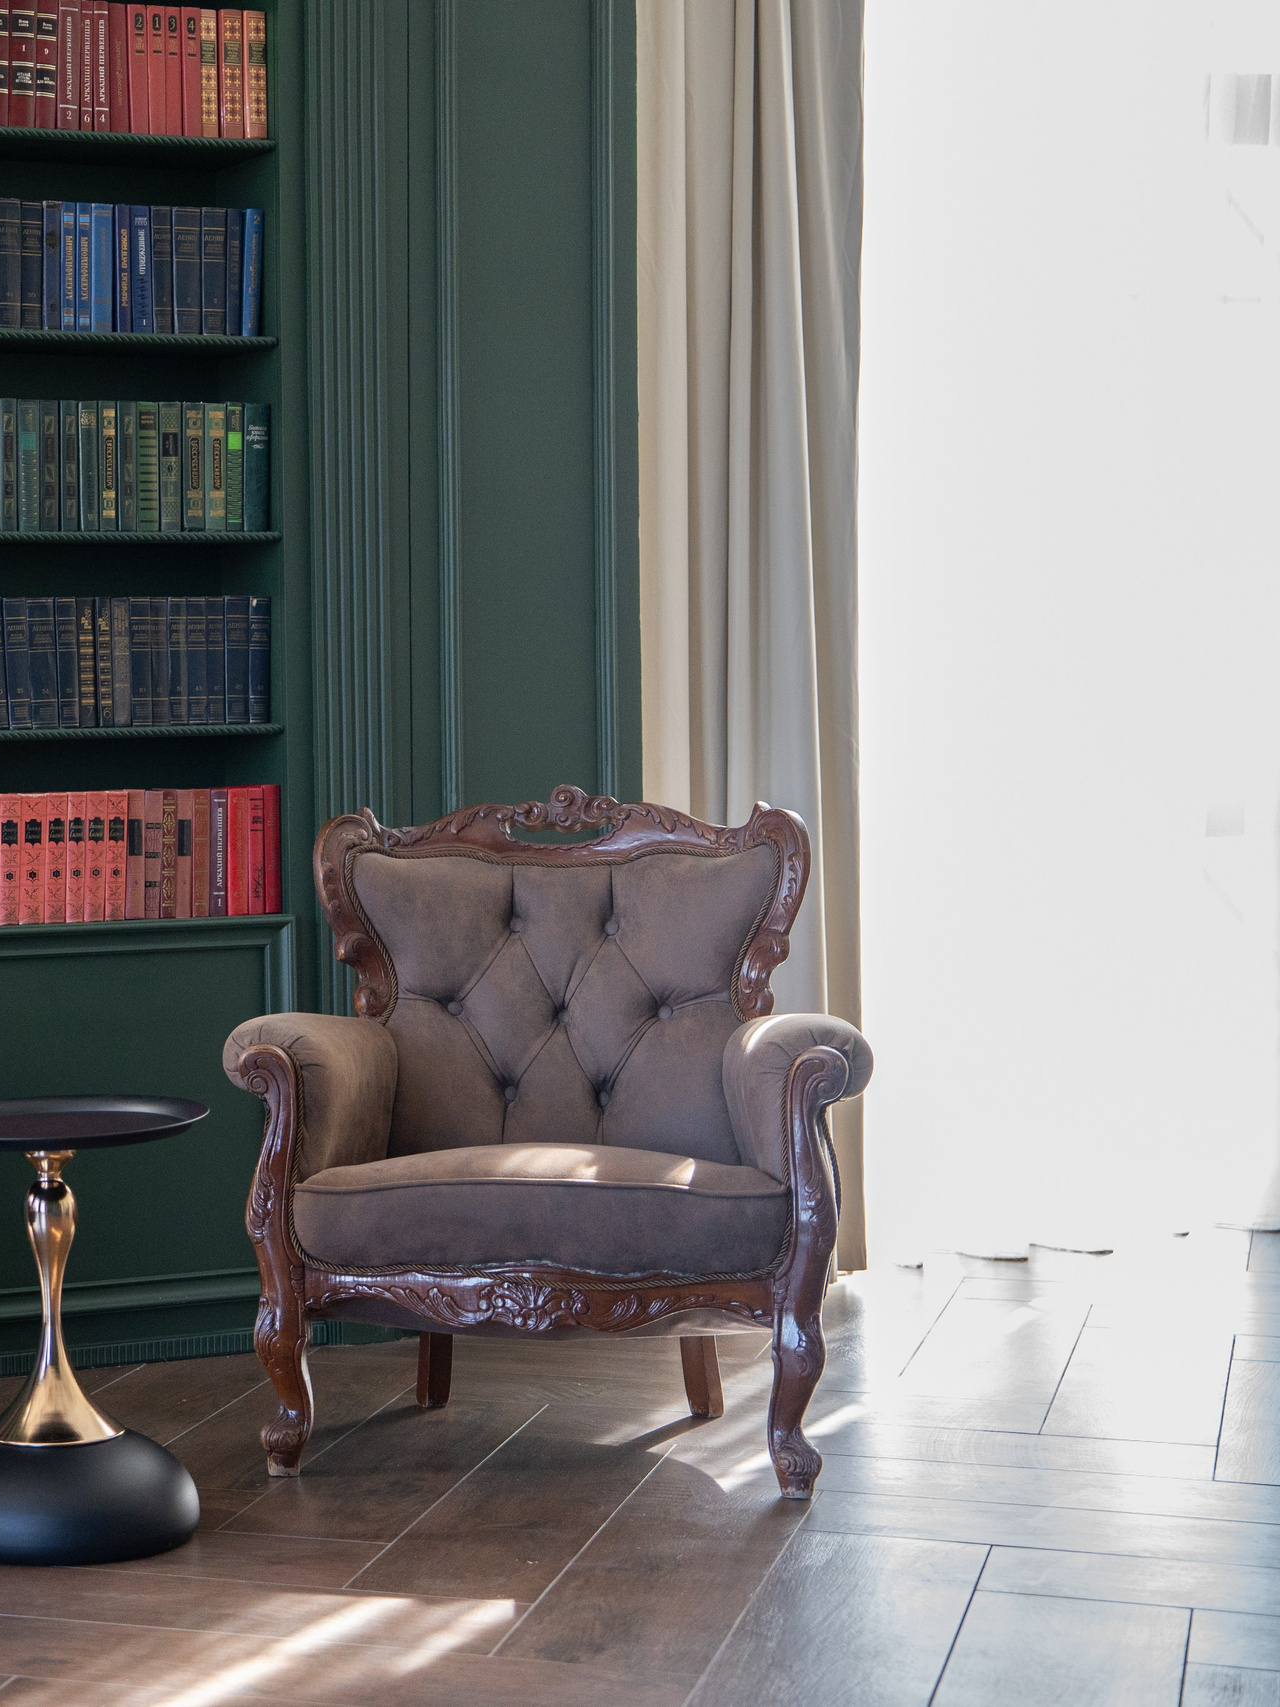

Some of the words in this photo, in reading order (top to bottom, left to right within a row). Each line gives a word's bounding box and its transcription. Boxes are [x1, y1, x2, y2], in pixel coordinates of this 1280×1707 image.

[136, 16, 142, 28] 2
[154, 16, 160, 28] 1
[170, 18, 176, 30] 3
[188, 19, 195, 30] 4
[66, 111, 72, 120] 2
[84, 115, 90, 124] 6
[99, 114, 106, 123] 4
[103, 708, 111, 718] 6
[218, 898, 221, 906] 1
